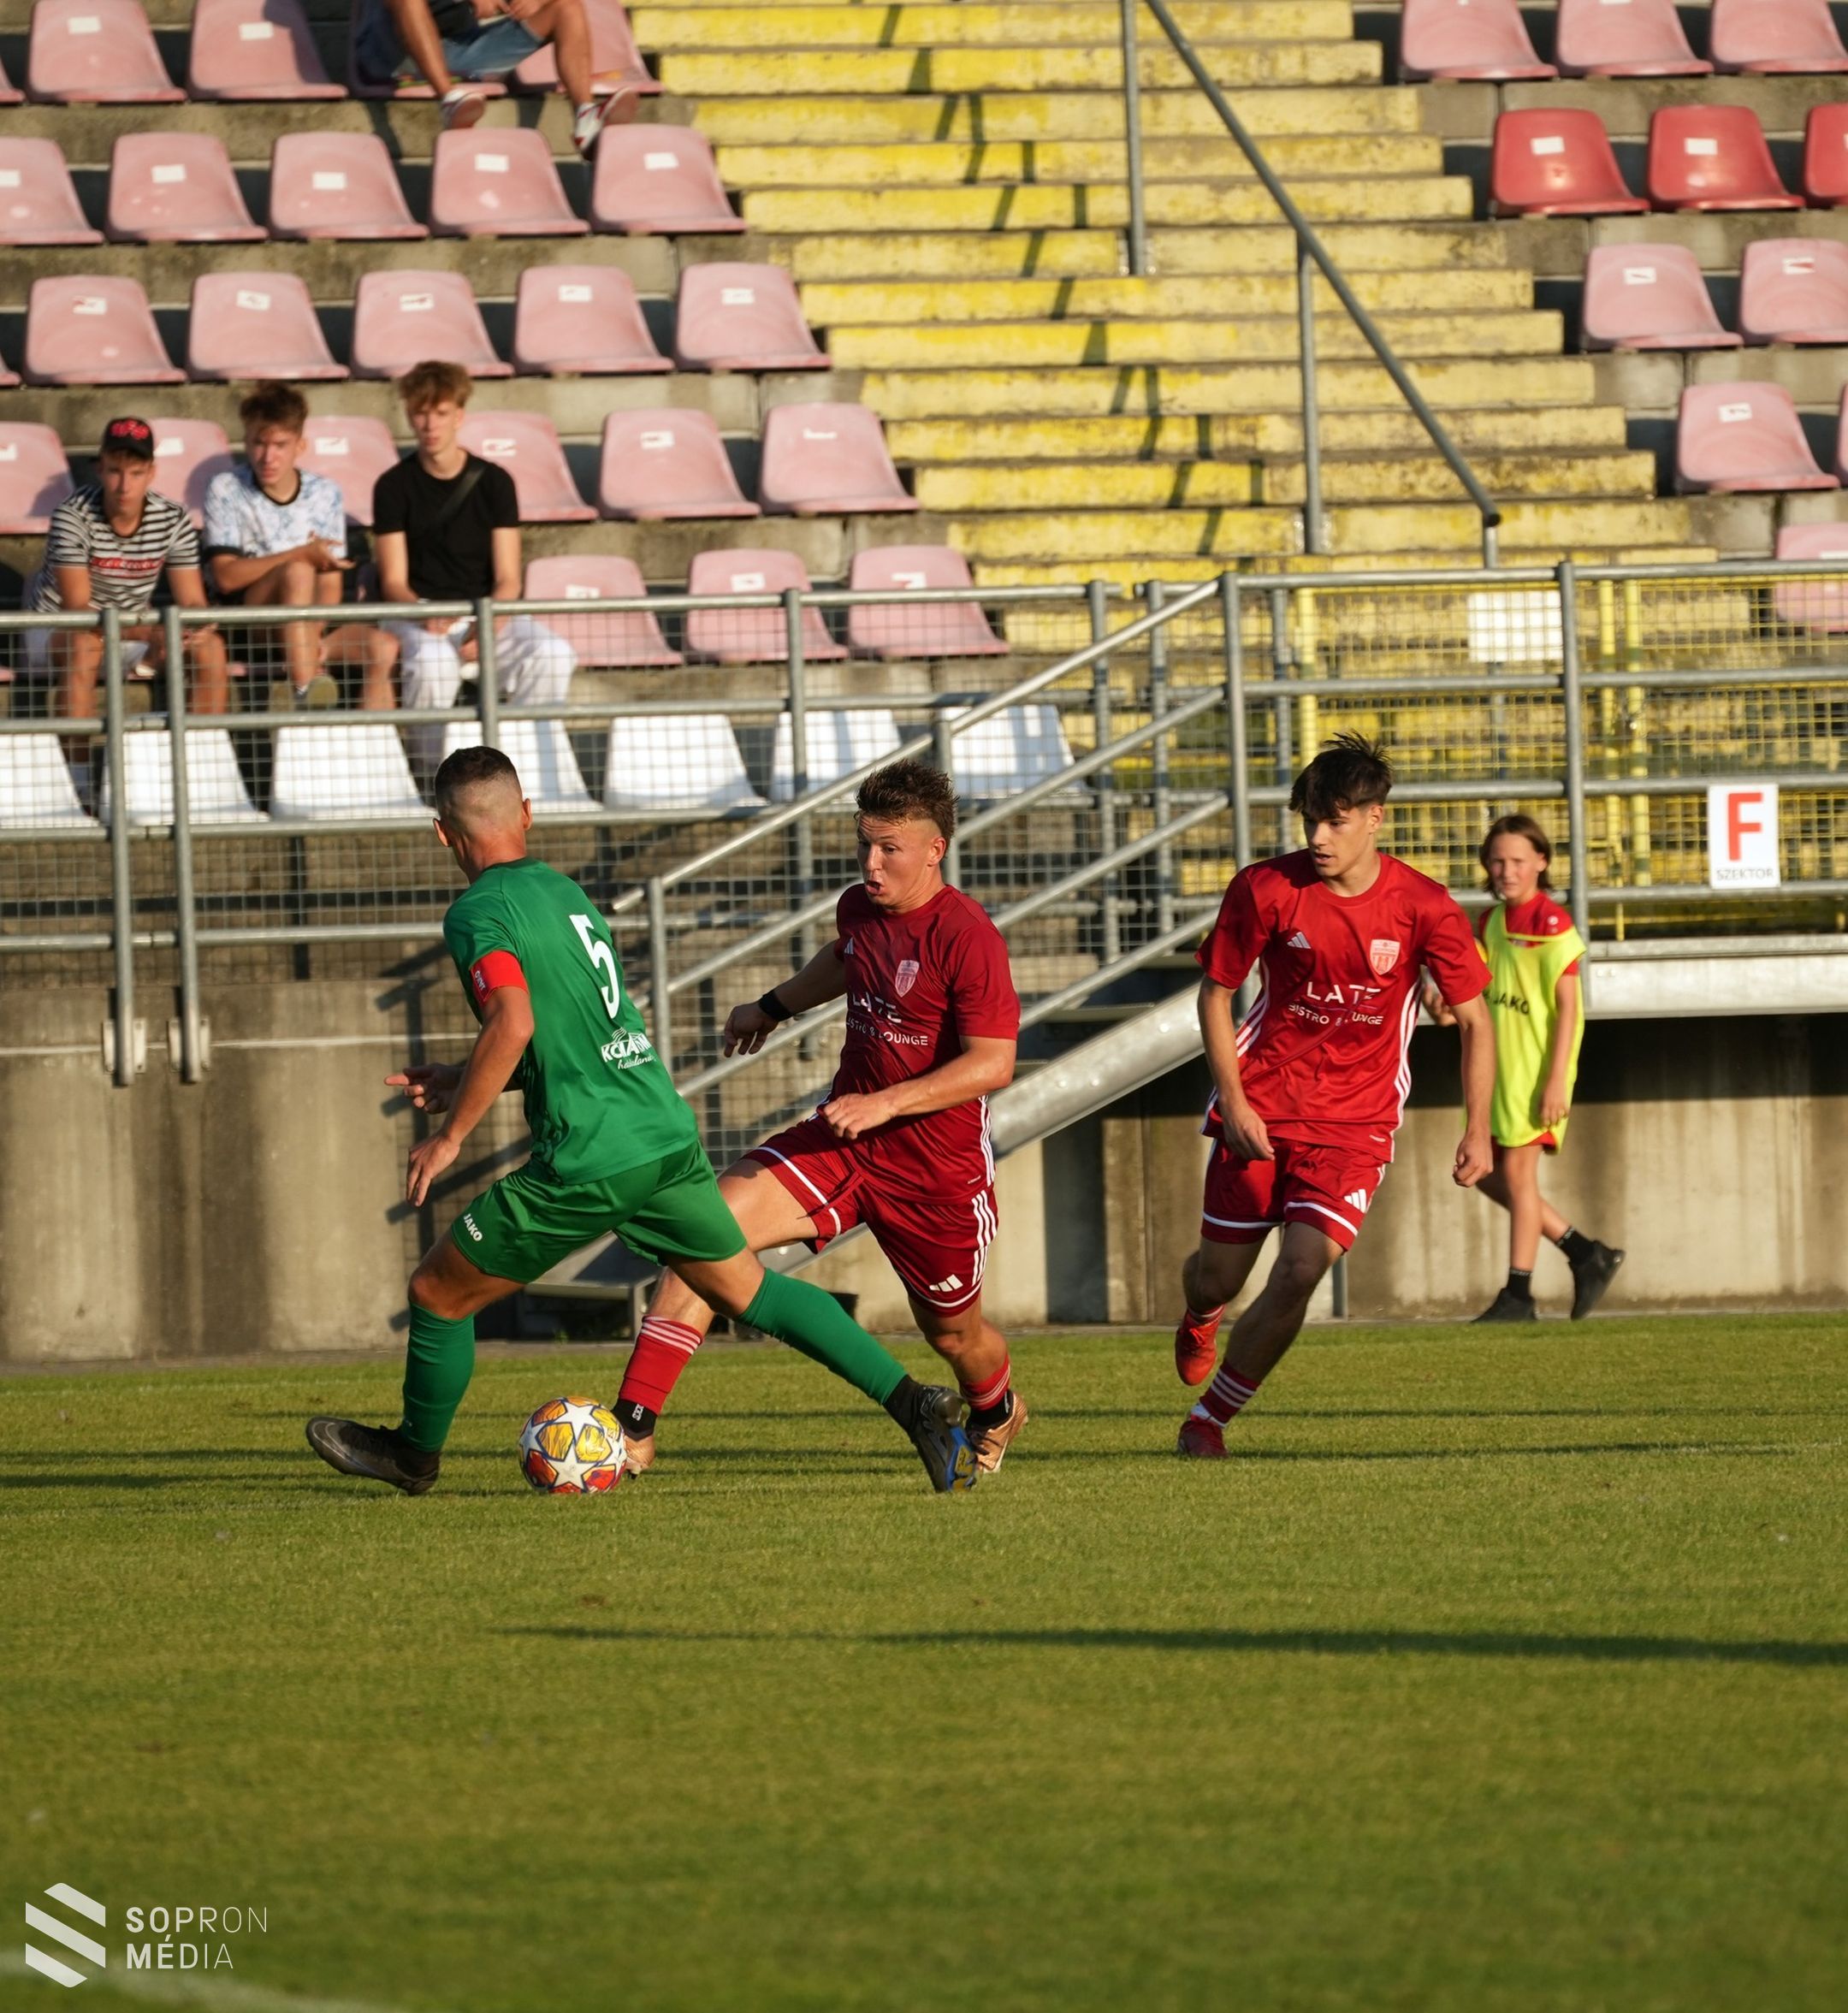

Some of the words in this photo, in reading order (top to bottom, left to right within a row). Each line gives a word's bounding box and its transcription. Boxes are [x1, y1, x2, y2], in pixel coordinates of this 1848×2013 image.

[1727, 792, 1763, 862] F
[1716, 867, 1774, 881] SZEKTOR
[569, 914, 619, 1020] 5
[1345, 1012, 1384, 1025] UNGE
[463, 1213, 483, 1241] JAKO
